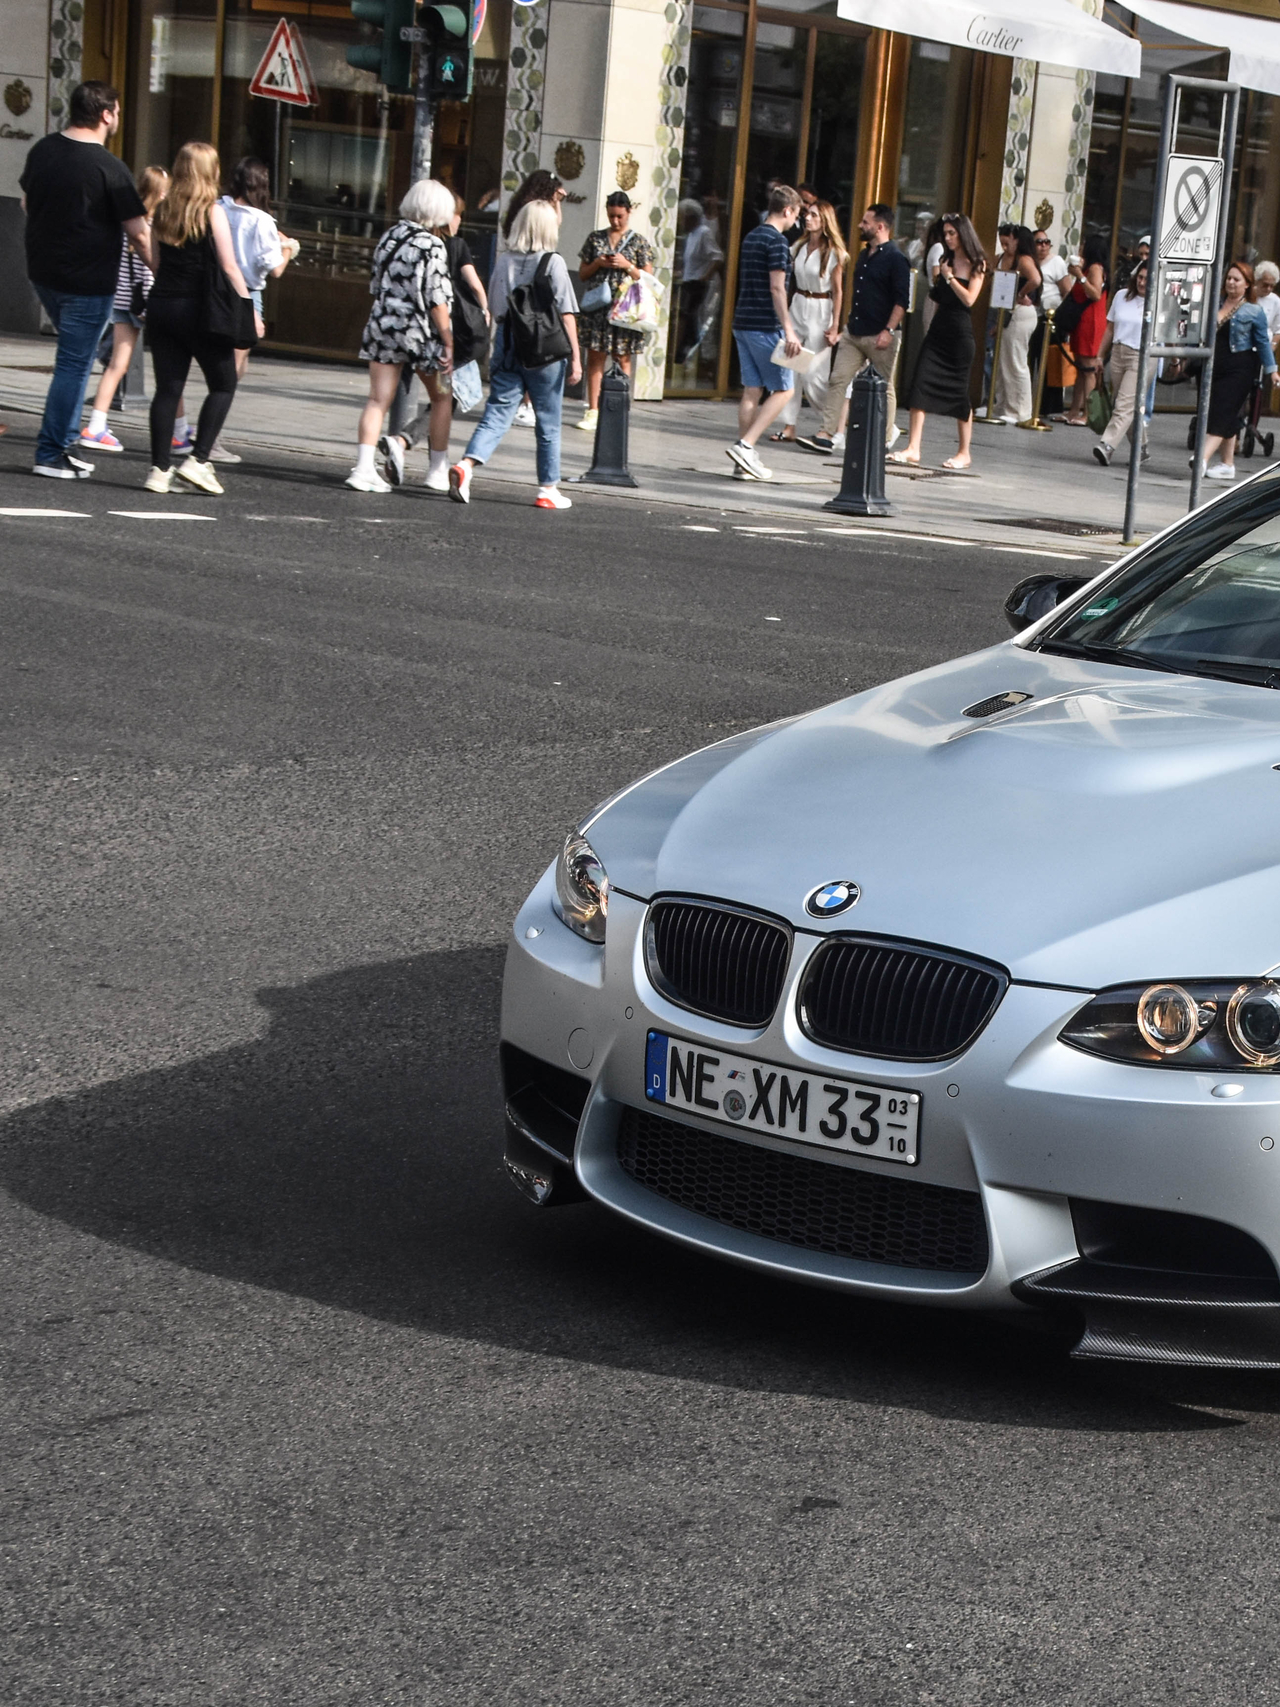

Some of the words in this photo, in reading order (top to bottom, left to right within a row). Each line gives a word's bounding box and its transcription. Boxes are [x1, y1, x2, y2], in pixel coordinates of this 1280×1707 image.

[966, 14, 1023, 51] Cartier
[1173, 237, 1201, 254] ZONE
[653, 1074, 661, 1088] D
[669, 1046, 720, 1110] NE
[748, 1068, 809, 1132] XM
[819, 1084, 881, 1145] 33
[888, 1098, 908, 1115] 03
[888, 1136, 907, 1153] 10
